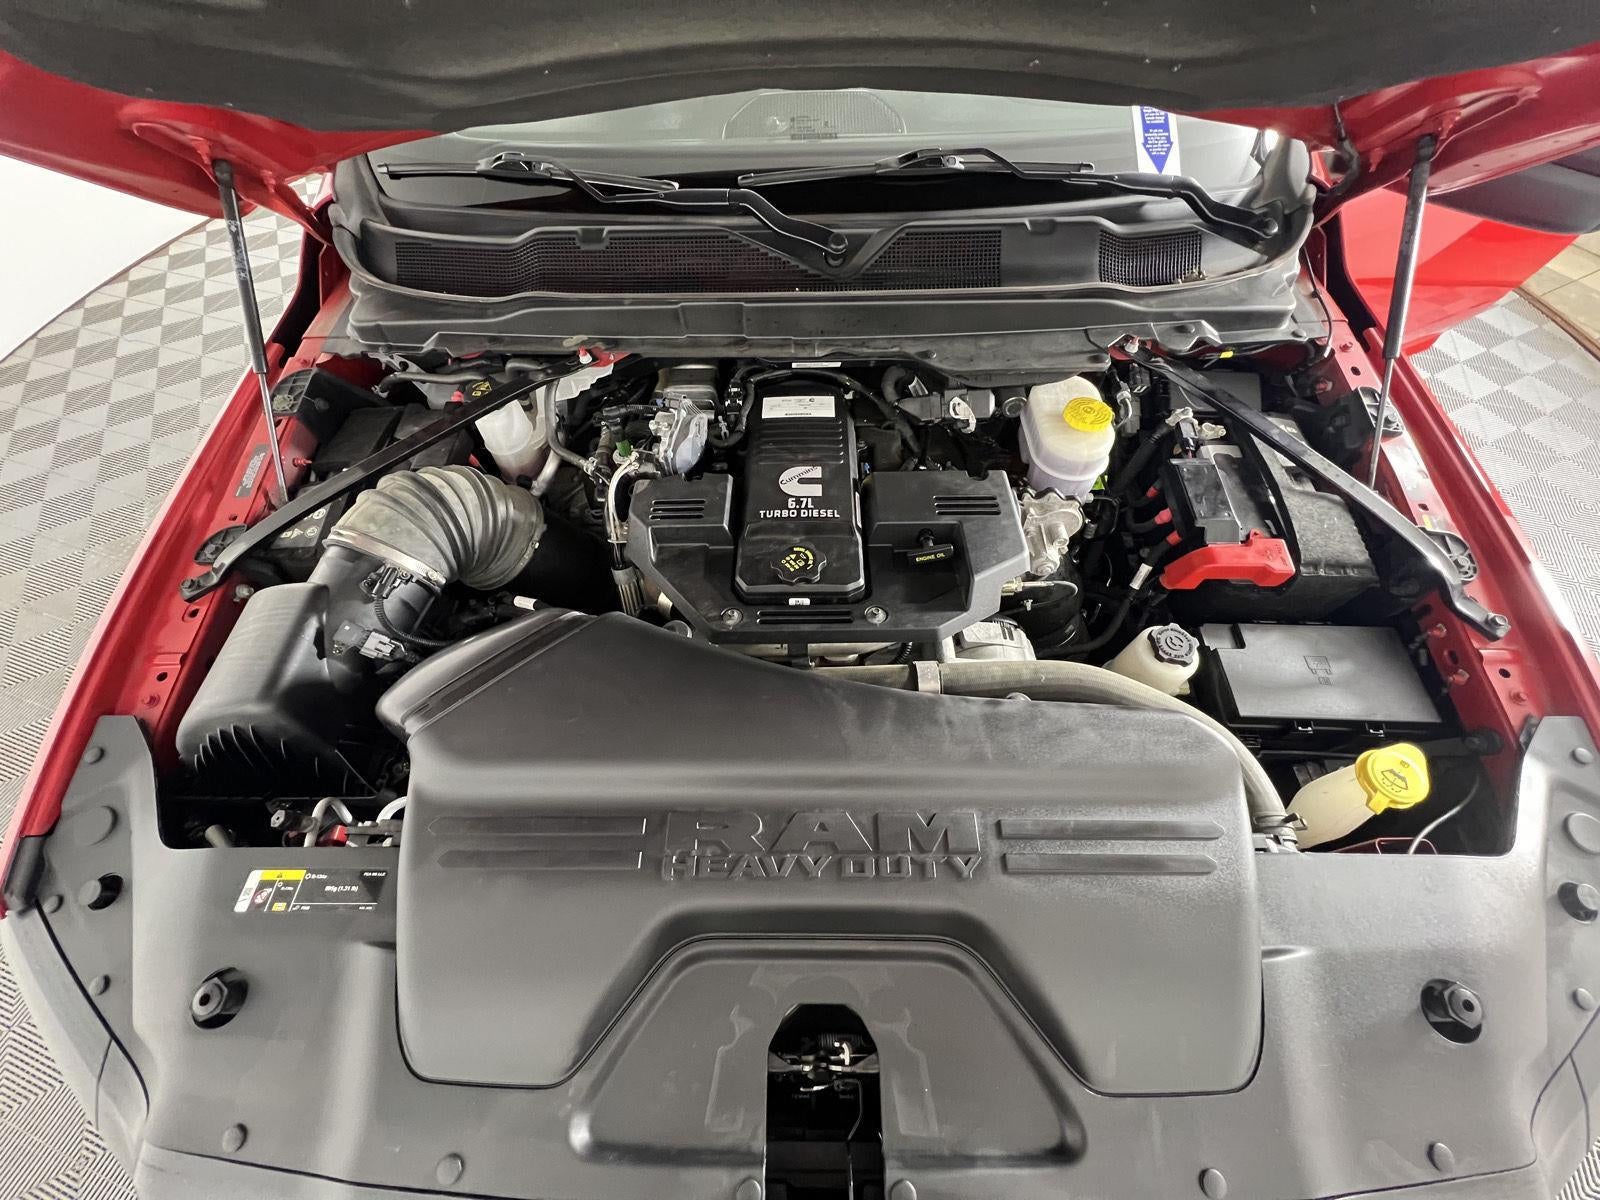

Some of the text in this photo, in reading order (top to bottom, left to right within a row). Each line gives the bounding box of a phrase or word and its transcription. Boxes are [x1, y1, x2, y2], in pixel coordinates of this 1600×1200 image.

[780, 464, 818, 485] Cummins
[787, 497, 815, 509] 6.7L
[759, 509, 841, 519] TURBO DIESEL
[915, 554, 936, 562] ENGINE
[666, 810, 982, 854] RAM
[661, 854, 982, 881] HEAVY DUTY
